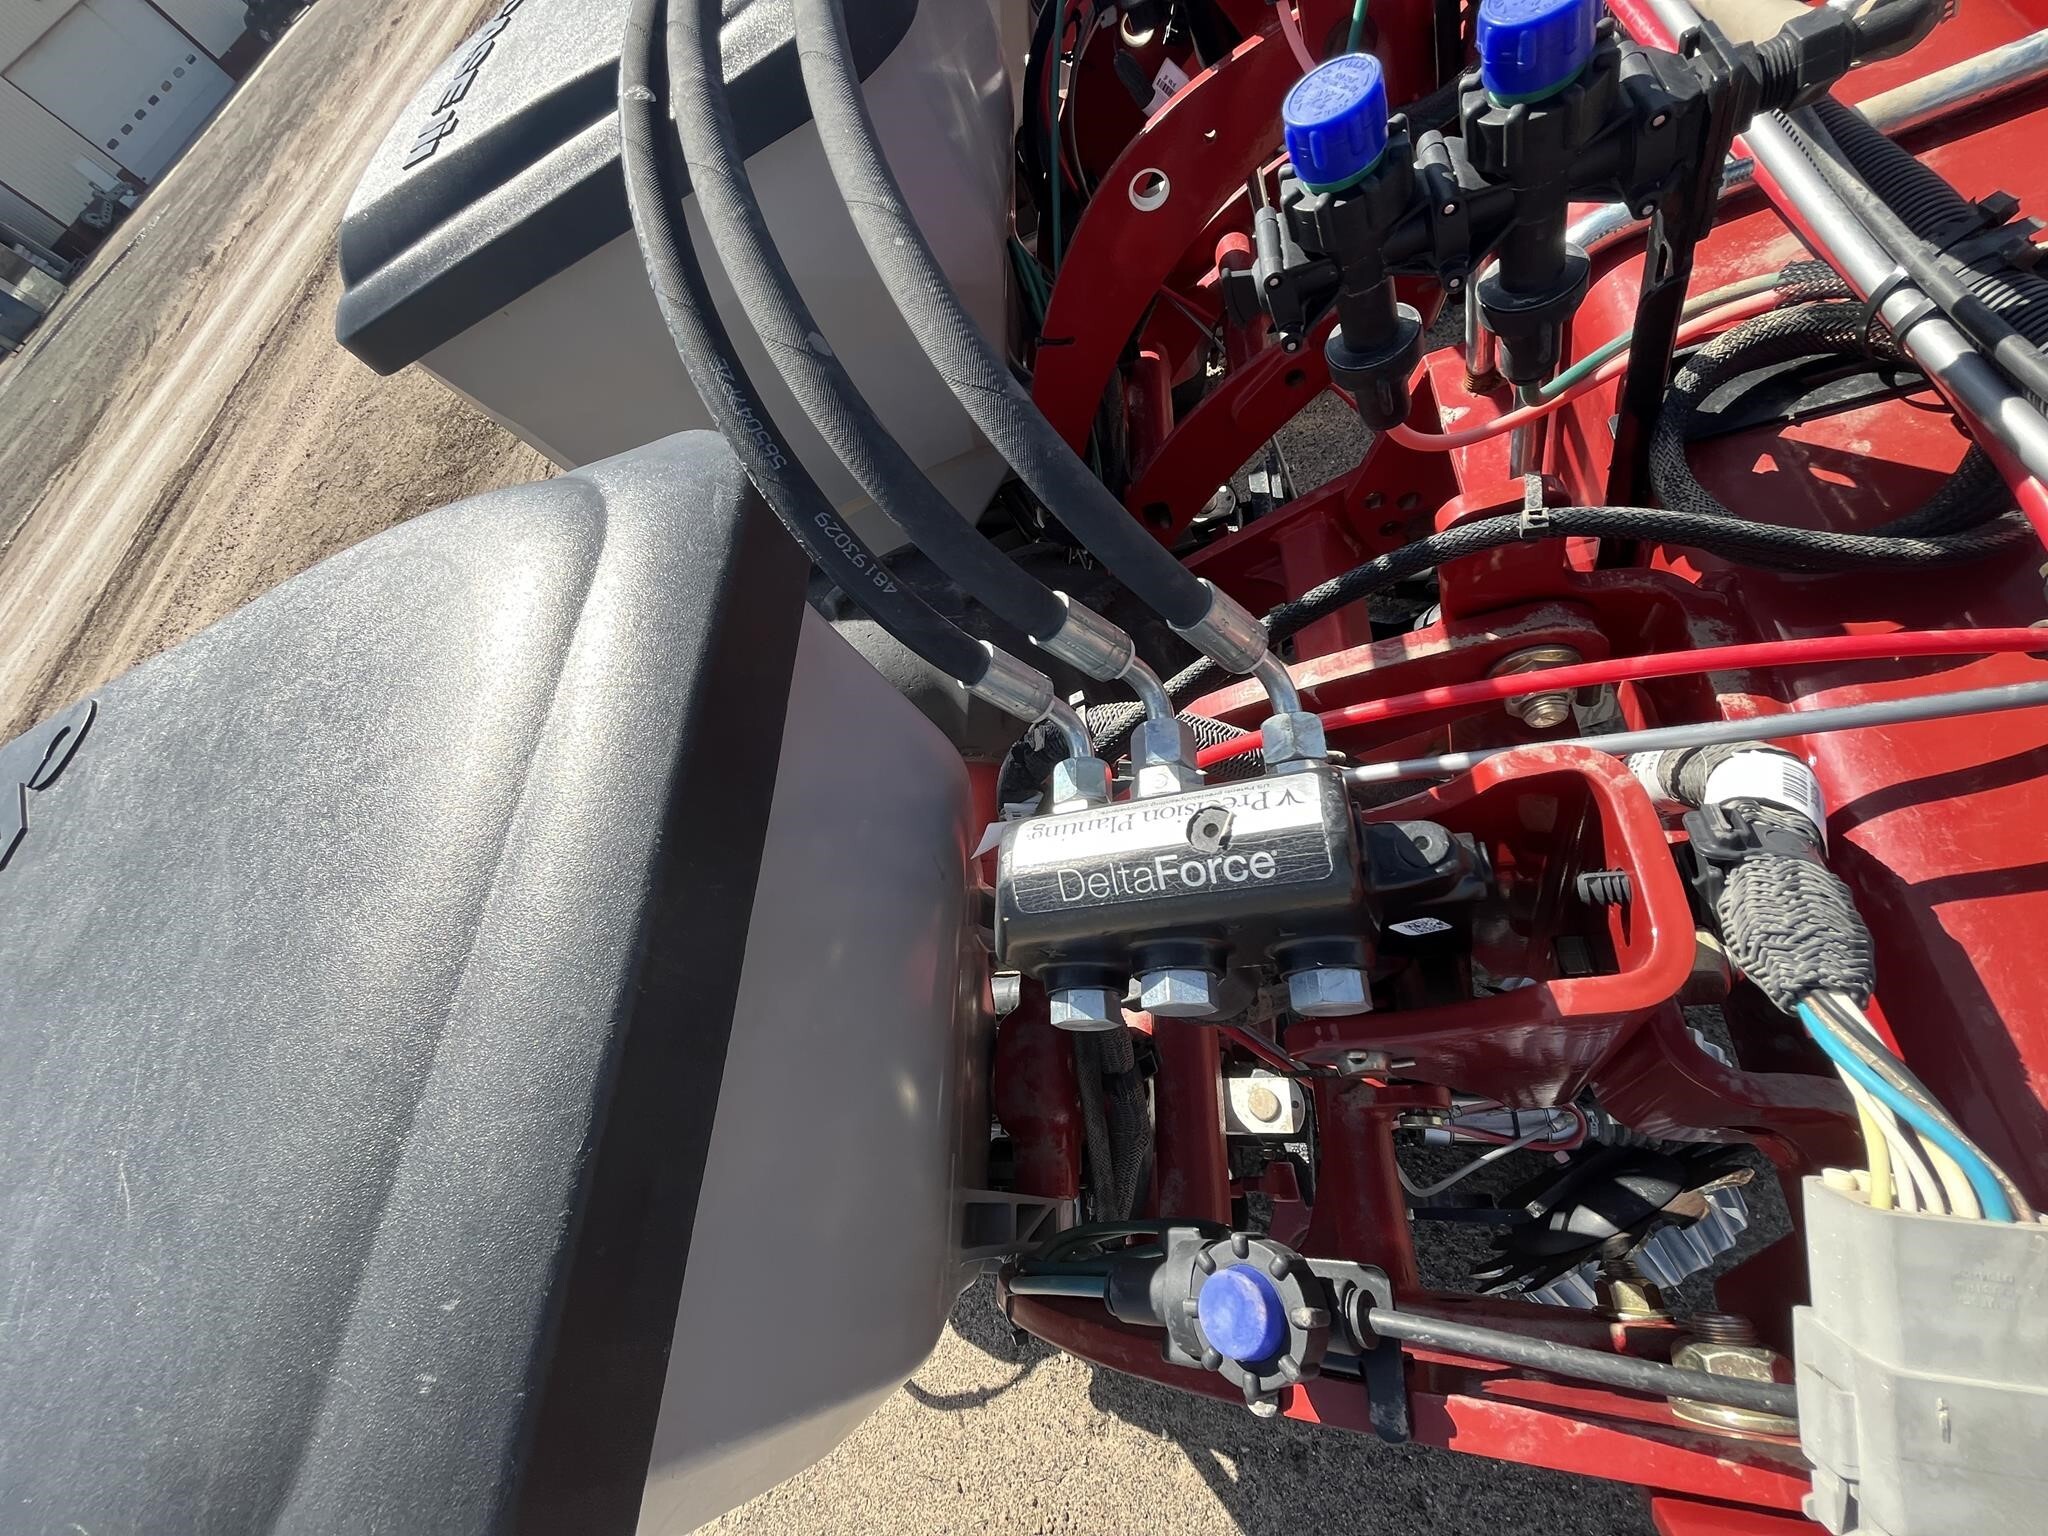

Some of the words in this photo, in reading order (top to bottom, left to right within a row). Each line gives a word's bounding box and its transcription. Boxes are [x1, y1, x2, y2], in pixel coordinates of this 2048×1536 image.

[813, 511, 898, 594] 48193029
[1031, 813, 1137, 842] Planting
[1057, 852, 1276, 902] DeltaForce
